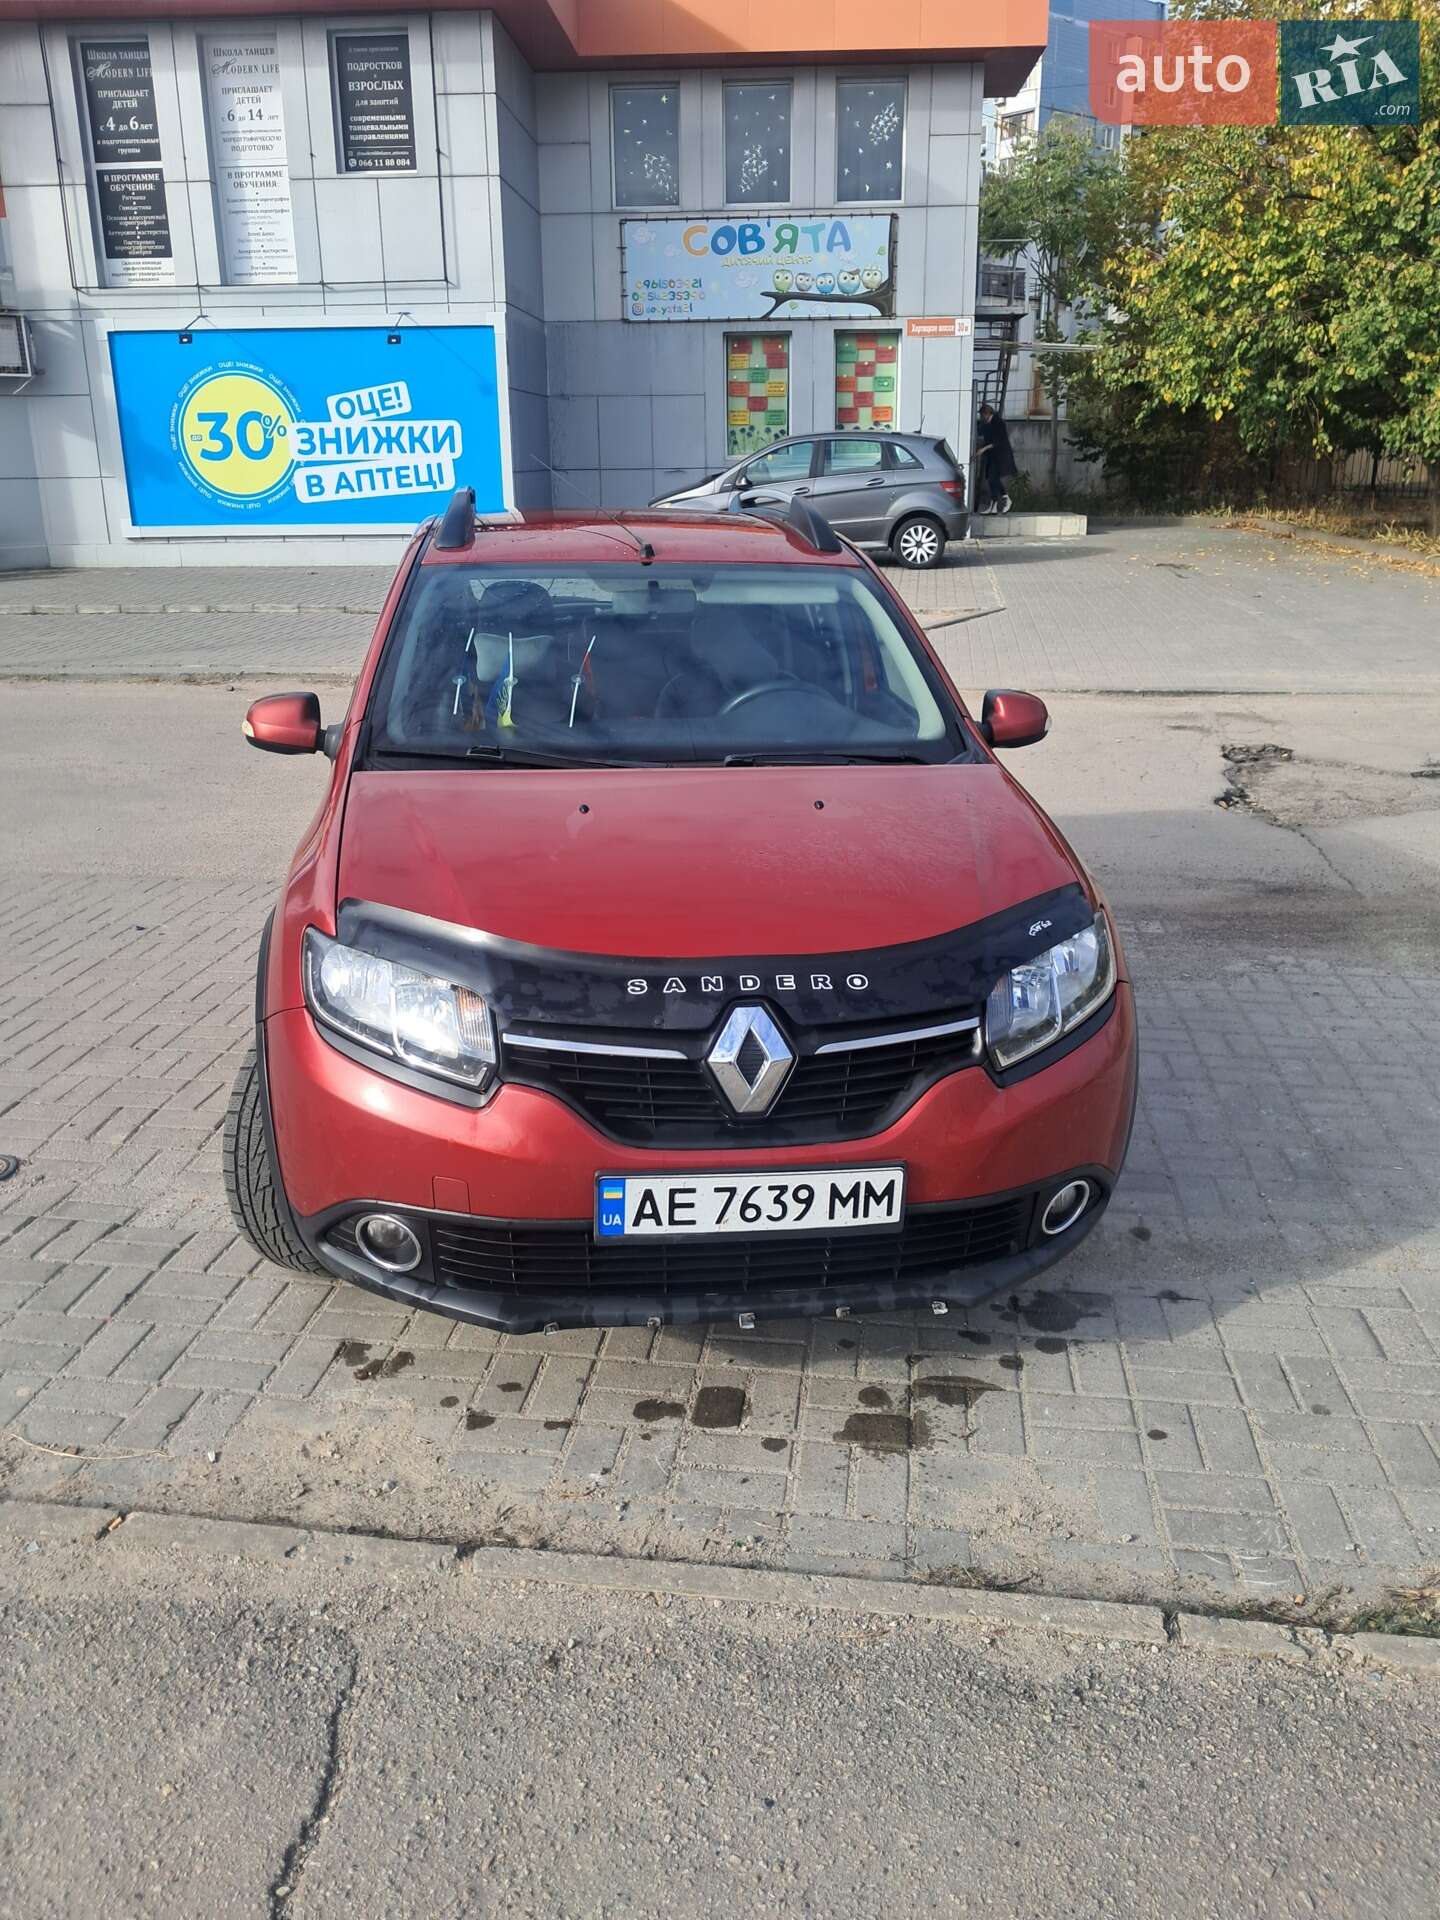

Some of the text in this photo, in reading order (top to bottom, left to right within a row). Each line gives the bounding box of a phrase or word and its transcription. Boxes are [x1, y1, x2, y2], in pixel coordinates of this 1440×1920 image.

[213, 48, 275, 56] ШКОЛА ТАНЦЕВ
[262, 64, 279, 73] LIFE
[347, 62, 402, 71] ПОДРОСТКОВ
[222, 86, 272, 95] ПРИГЛАШАЕТ
[348, 81, 404, 91] ВЗРОСЛЫХ
[98, 90, 149, 98] ПРИГЛАШАЕТ
[112, 98, 137, 109] ДЕТЕЙ
[236, 95, 261, 105] ДЕТЕЙ
[369, 97, 398, 105] занятий
[227, 109, 235, 121] 6
[248, 108, 263, 120] 14
[106, 117, 115, 131] 4
[130, 116, 139, 130] 6
[348, 124, 408, 132] танцевальными
[350, 133, 409, 142] направлениями
[231, 144, 274, 152] ПОДГОТОВКУ
[111, 174, 160, 182] ПРОГРАММЕ
[235, 170, 283, 178] ПРОГРАММЕ
[683, 219, 851, 256] СОВ'ЯТА
[335, 386, 403, 419] ОЦЕ!
[296, 426, 456, 455] ЗНИЖКИ
[305, 463, 444, 497] В АПТЕЦІ
[627, 974, 869, 994] SANDERO
[632, 1179, 895, 1227] AE 7639 MM
[603, 1213, 622, 1226] UA
